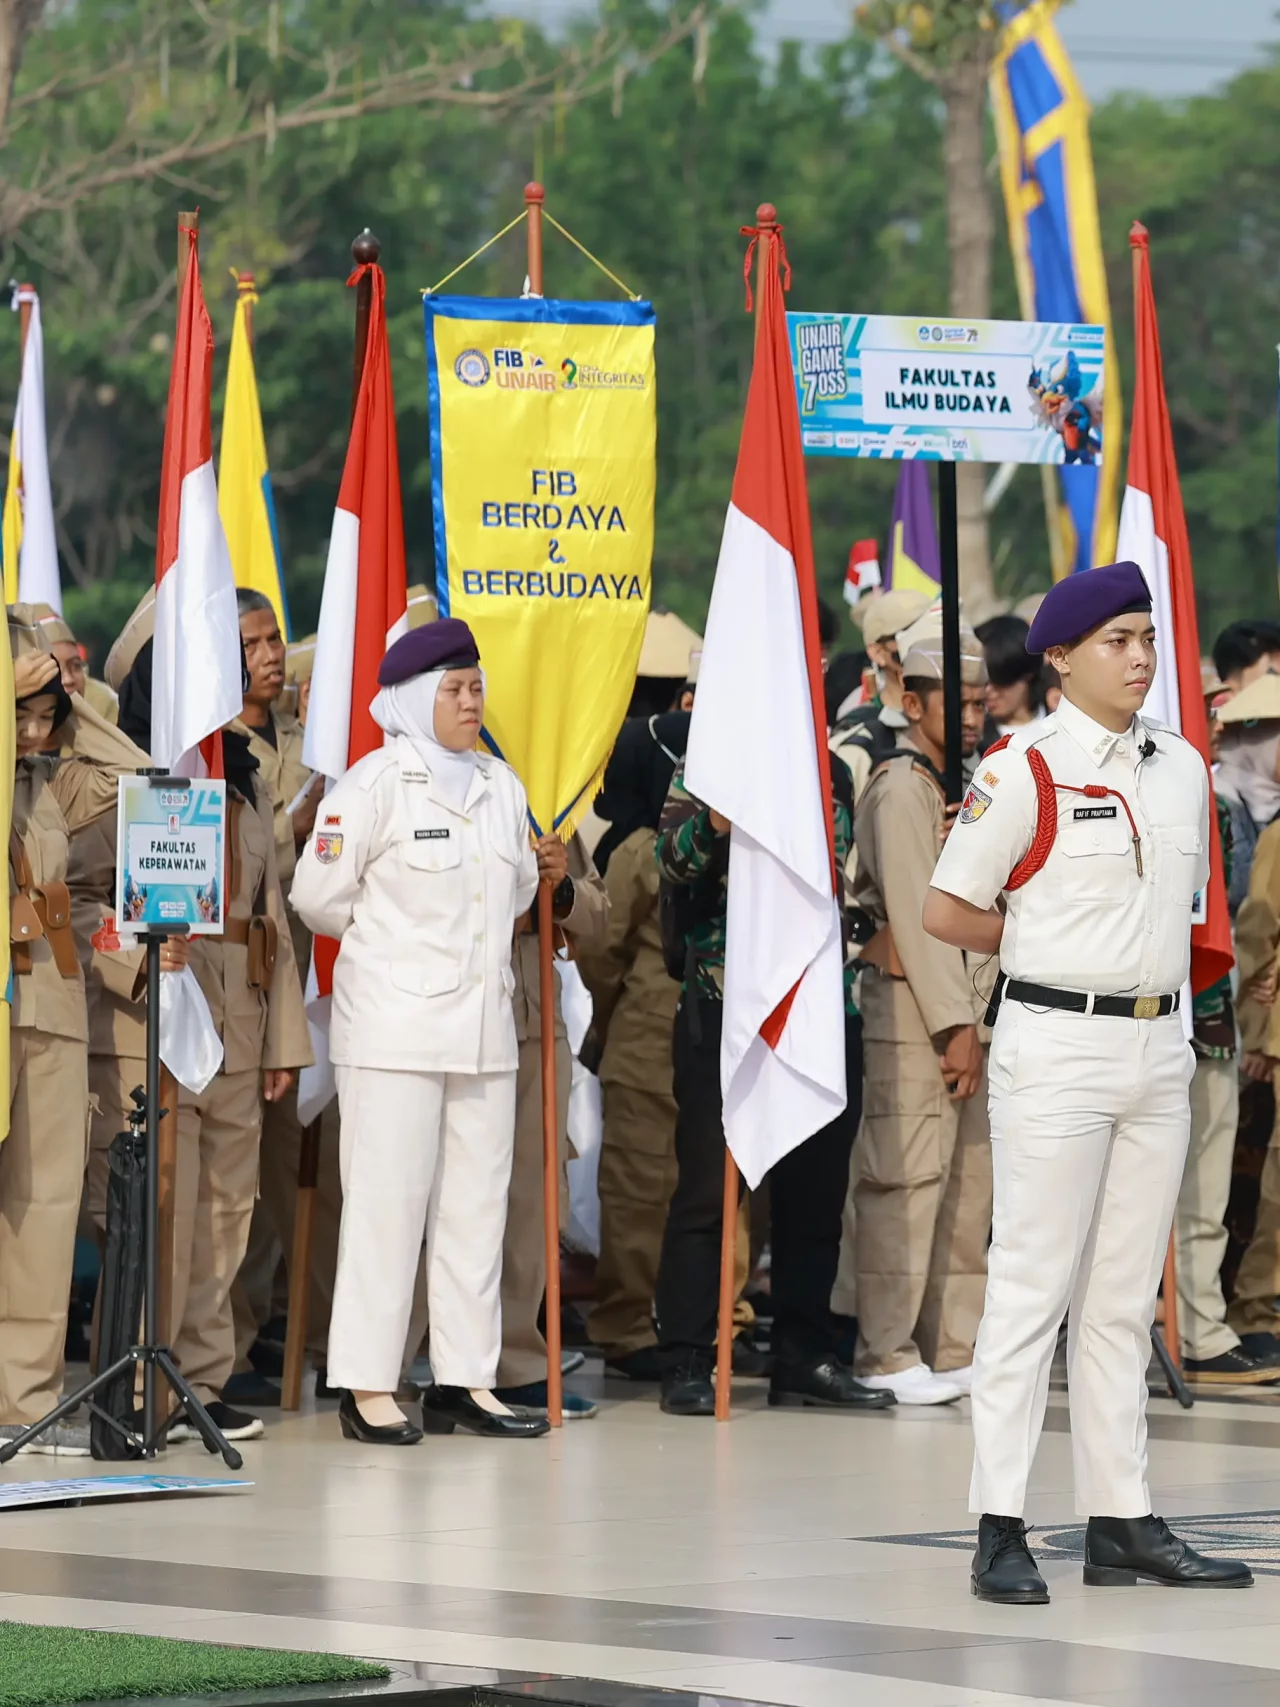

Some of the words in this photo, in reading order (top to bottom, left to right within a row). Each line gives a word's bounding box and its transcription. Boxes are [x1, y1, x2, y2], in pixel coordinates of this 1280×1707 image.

[801, 323, 841, 349] UNAIR
[494, 350, 523, 368] FIB
[802, 346, 843, 372] GAME
[496, 371, 556, 391] UNAIR
[579, 372, 645, 385] INTEGRITAS
[899, 368, 996, 388] FAKULTAS
[885, 391, 927, 411] ILMU
[935, 393, 1011, 413] BUDAYA
[532, 470, 577, 496] FIB
[482, 502, 626, 532] BERDAYA
[462, 570, 643, 600] BERBUDAYA
[150, 841, 196, 854] FAKULTAS
[139, 858, 206, 871] KEPERAWATAN
